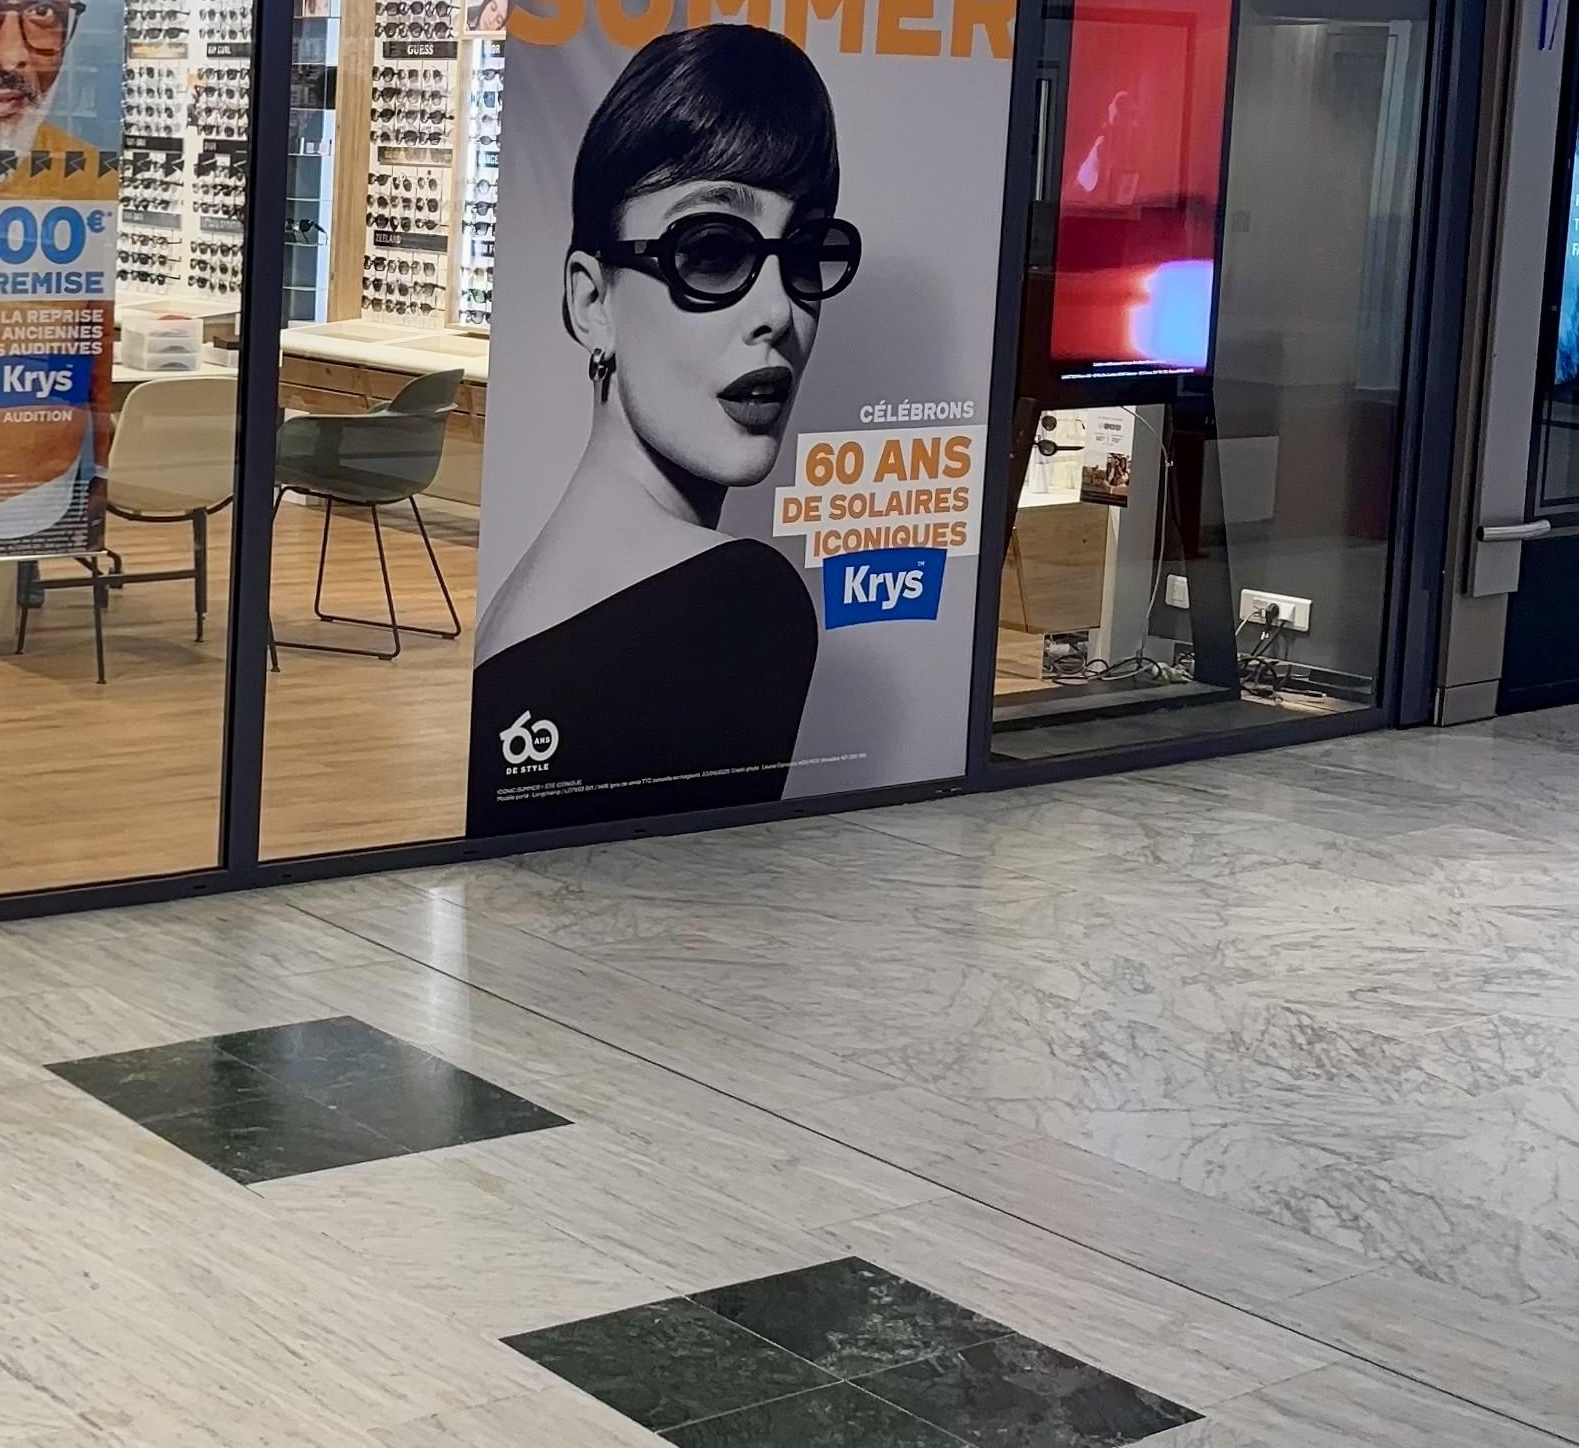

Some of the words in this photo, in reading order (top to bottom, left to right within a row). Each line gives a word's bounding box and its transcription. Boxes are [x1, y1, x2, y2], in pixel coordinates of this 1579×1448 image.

[407, 44, 434, 56] GUESS
[0, 310, 23, 324] LA
[26, 309, 105, 324] REPRISE
[1, 325, 104, 340] ANCIENNES
[8, 341, 104, 356] AUDITIVES
[2, 364, 73, 398] Krys
[2, 410, 73, 423] AUDITION
[859, 398, 975, 424] CÉLÉBRONS
[805, 440, 865, 487] 60
[873, 435, 972, 483] ANS
[781, 495, 822, 525] DE
[828, 486, 970, 521] SOLAIRES
[813, 521, 968, 558] ICONIQUES
[843, 564, 925, 610] Krys
[498, 709, 560, 764] 60
[533, 736, 551, 745] ANS
[505, 767, 518, 775] DE
[520, 763, 550, 774] STYLE
